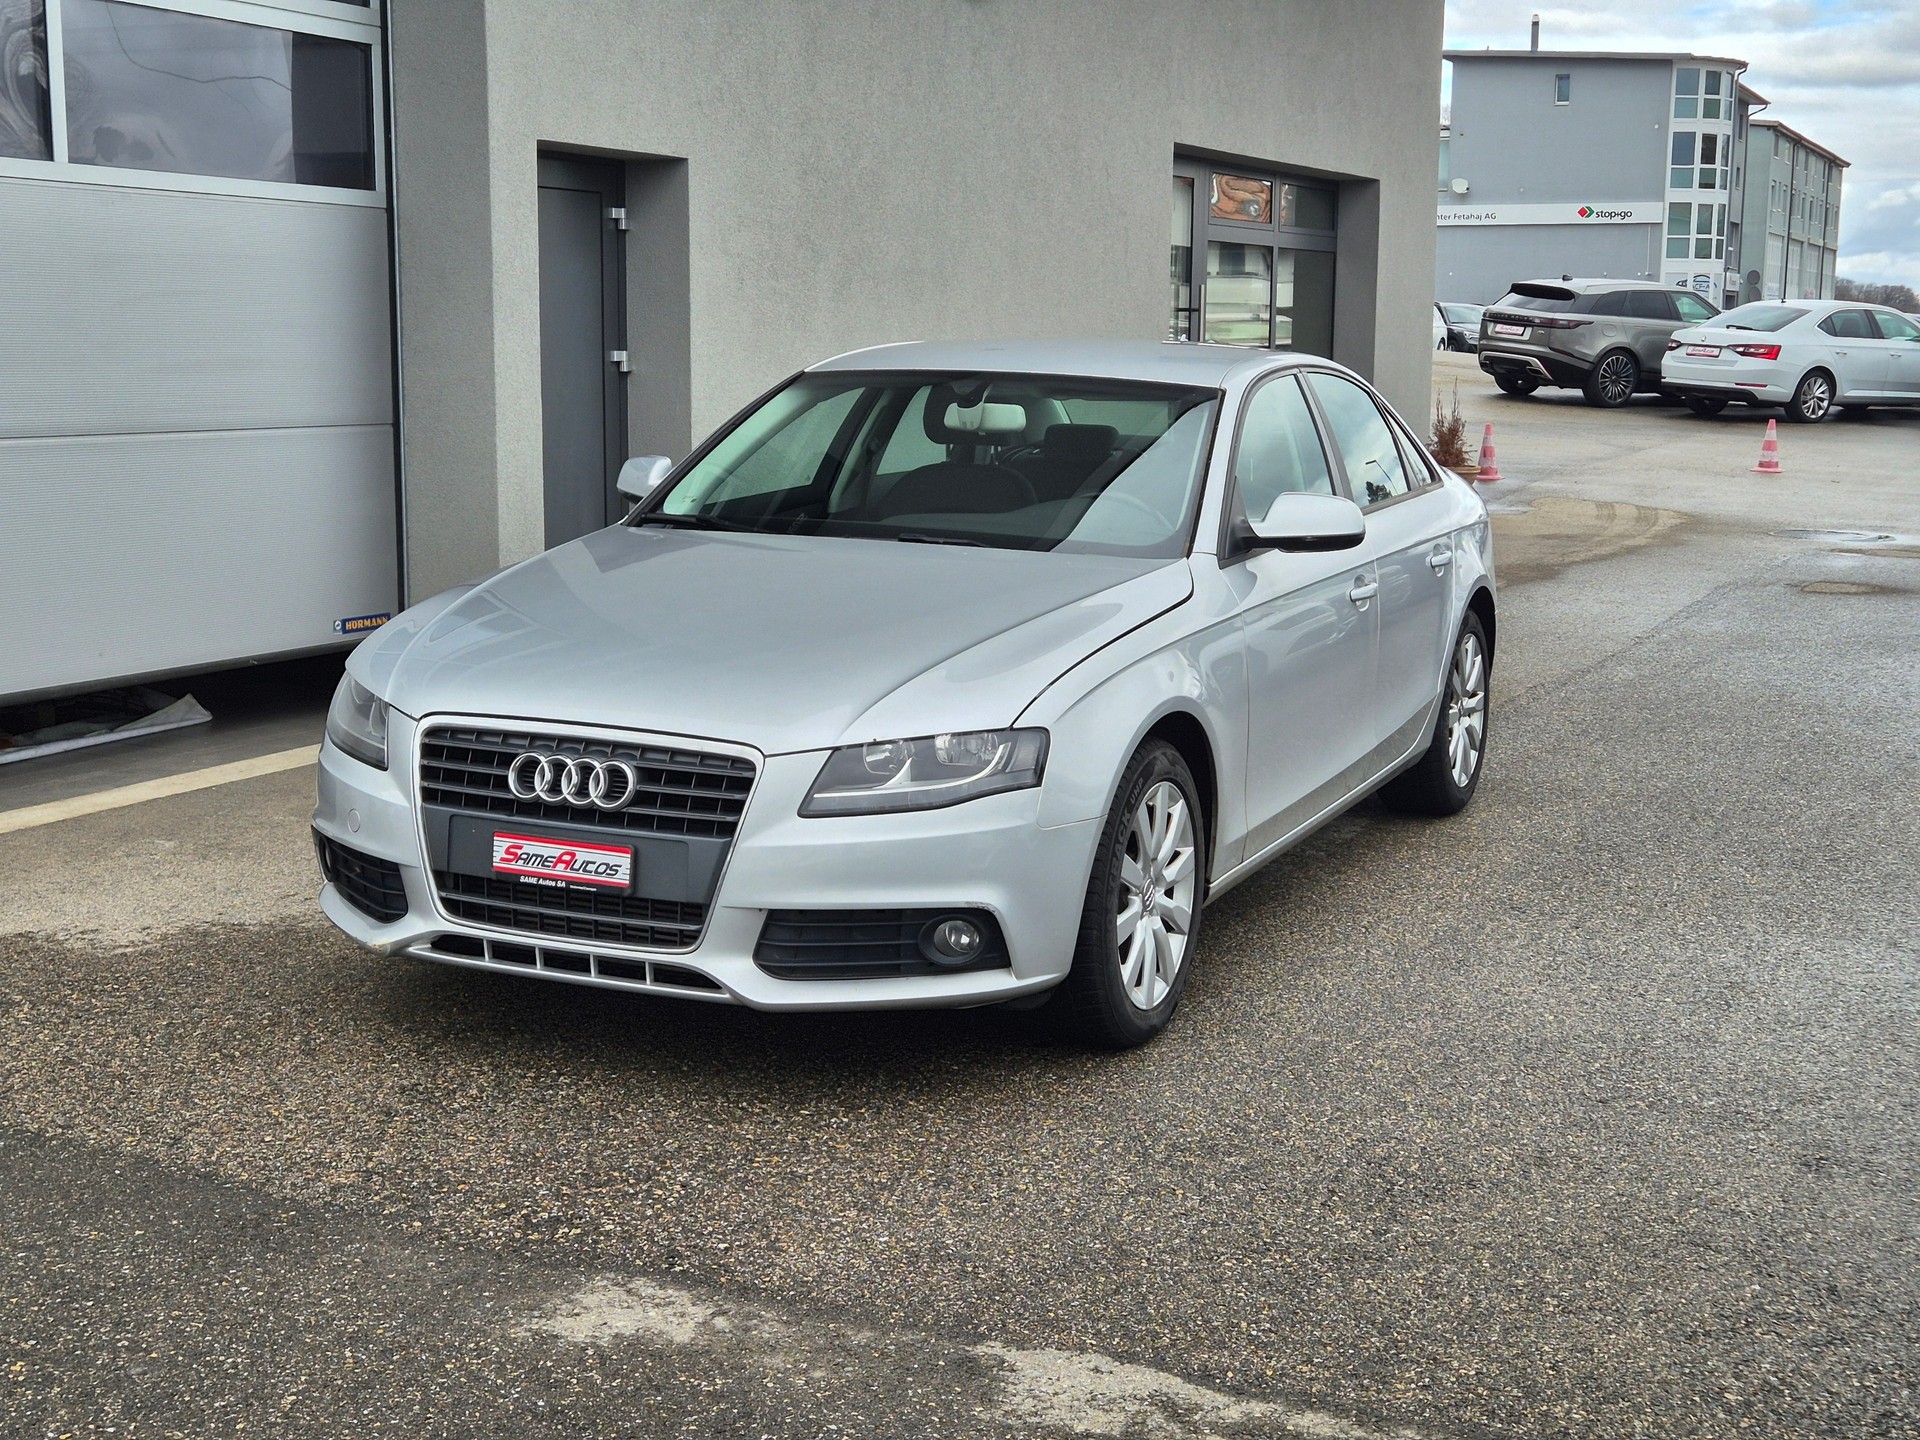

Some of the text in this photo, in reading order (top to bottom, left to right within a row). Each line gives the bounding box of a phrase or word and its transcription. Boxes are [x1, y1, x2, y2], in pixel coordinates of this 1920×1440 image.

[1453, 212, 1482, 221] Fetahaj
[1484, 212, 1497, 220] AG
[520, 875, 538, 885] SAME
[538, 878, 556, 887] Autos
[556, 879, 566, 888] SA
